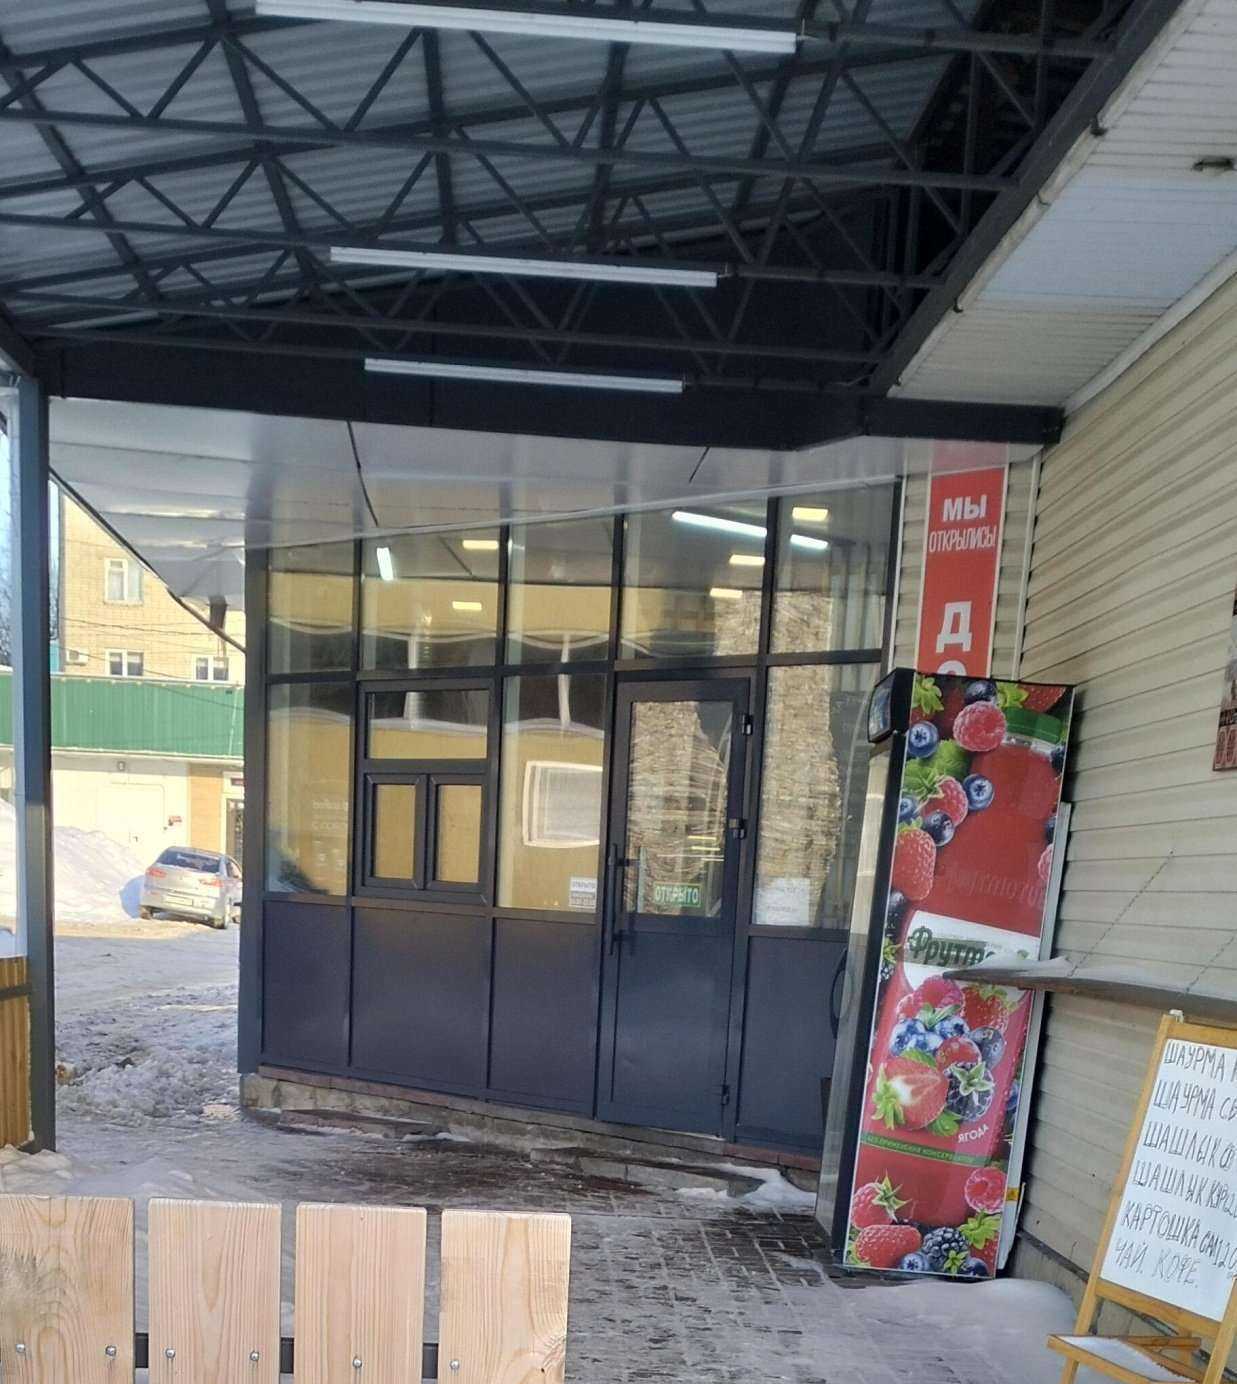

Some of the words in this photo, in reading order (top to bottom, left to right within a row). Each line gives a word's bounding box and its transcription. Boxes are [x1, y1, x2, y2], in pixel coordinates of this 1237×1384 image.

[943, 494, 988, 522] МЫ
[655, 886, 699, 904] ОТКРЫТО
[1164, 1041, 1226, 1082] ШАУРМА
[1153, 1079, 1217, 1120] ШАУРМА
[957, 1124, 990, 1143] ЯГОДА
[1143, 1120, 1222, 1168] ШАШЛЫК
[1133, 1160, 1209, 1206] ШАШЛЫК
[1121, 1200, 1201, 1248] КАРТОШКА
